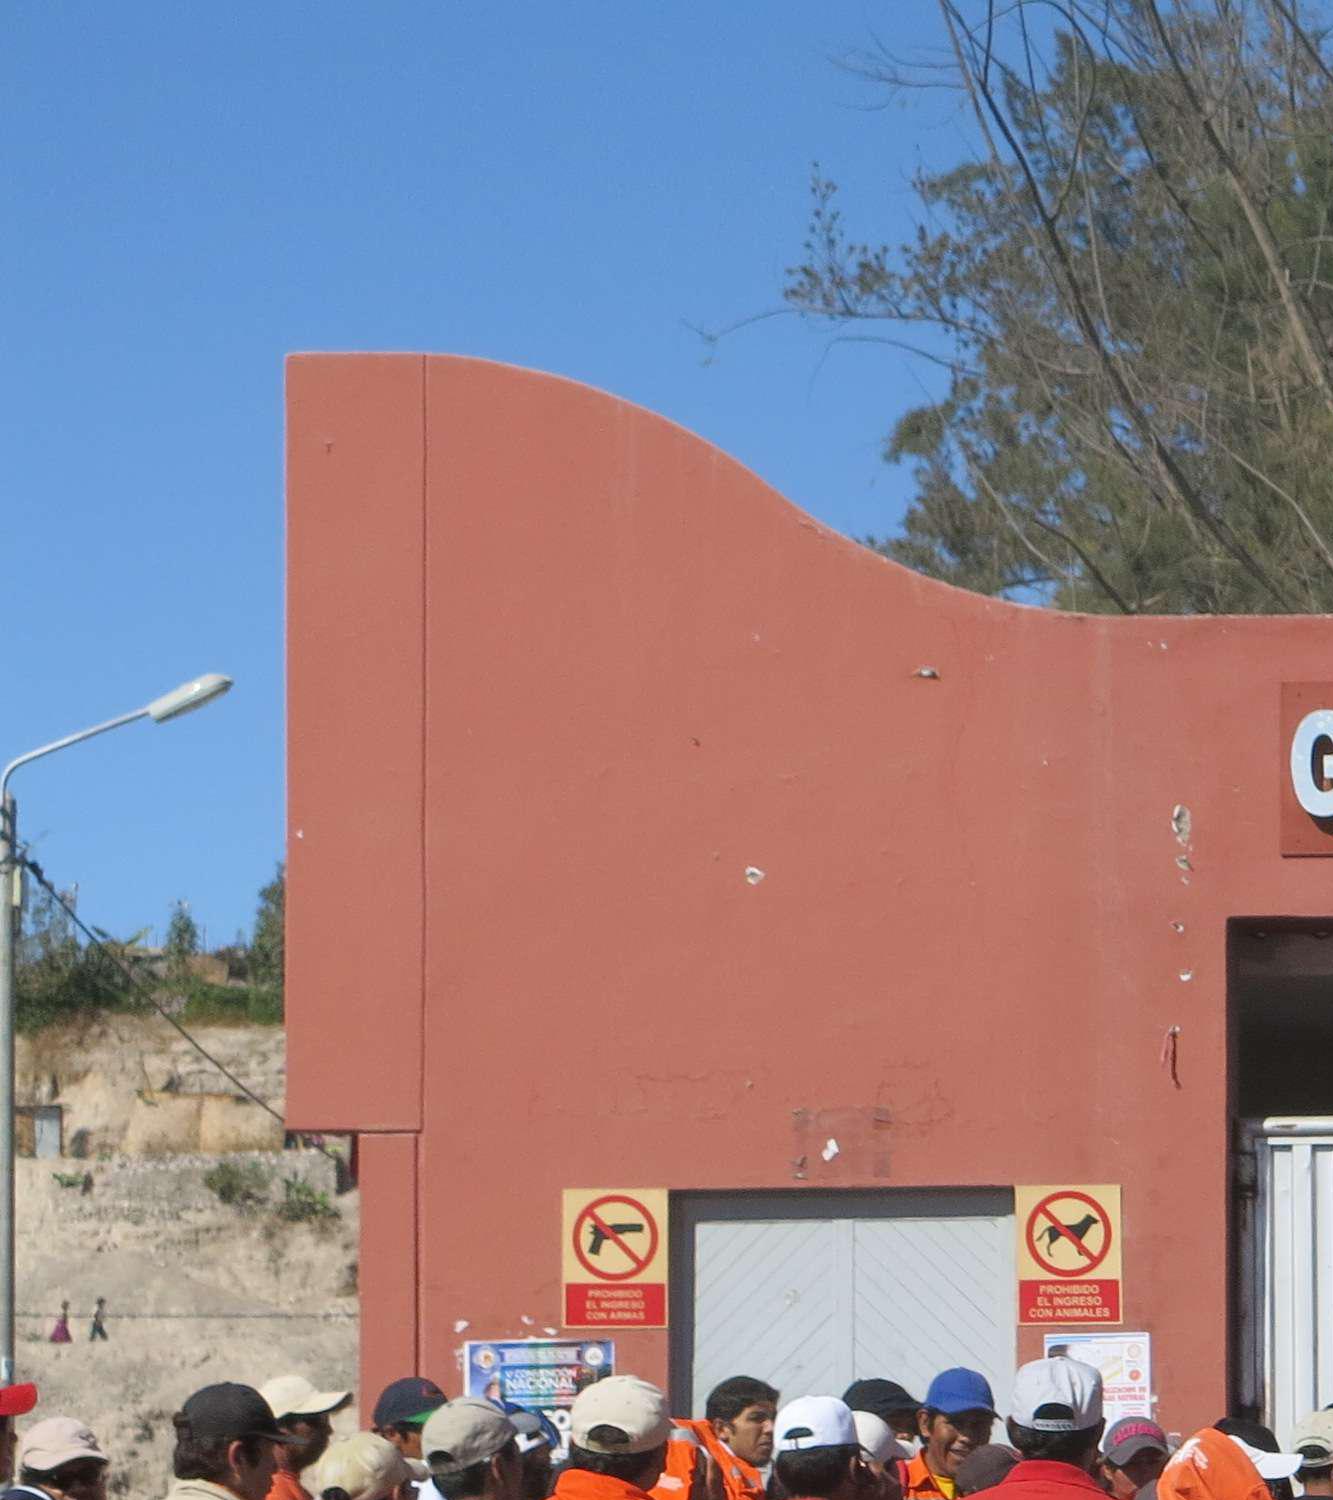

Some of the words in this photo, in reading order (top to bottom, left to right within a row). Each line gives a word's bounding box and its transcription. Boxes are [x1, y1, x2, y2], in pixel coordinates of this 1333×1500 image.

[587, 1288, 644, 1299] PROHIBIDO
[1039, 1285, 1100, 1295] PROHIBIDO
[585, 1299, 598, 1310] EL
[600, 1299, 646, 1310] INGRESO
[1037, 1296, 1051, 1307] EL
[1053, 1295, 1103, 1306] INGRESO
[585, 1310, 608, 1321] CON
[608, 1310, 646, 1320] ARMAS
[1028, 1308, 1053, 1318] CON
[1055, 1307, 1111, 1318] ANIMALES
[505, 1377, 577, 1391] NACIONAL
